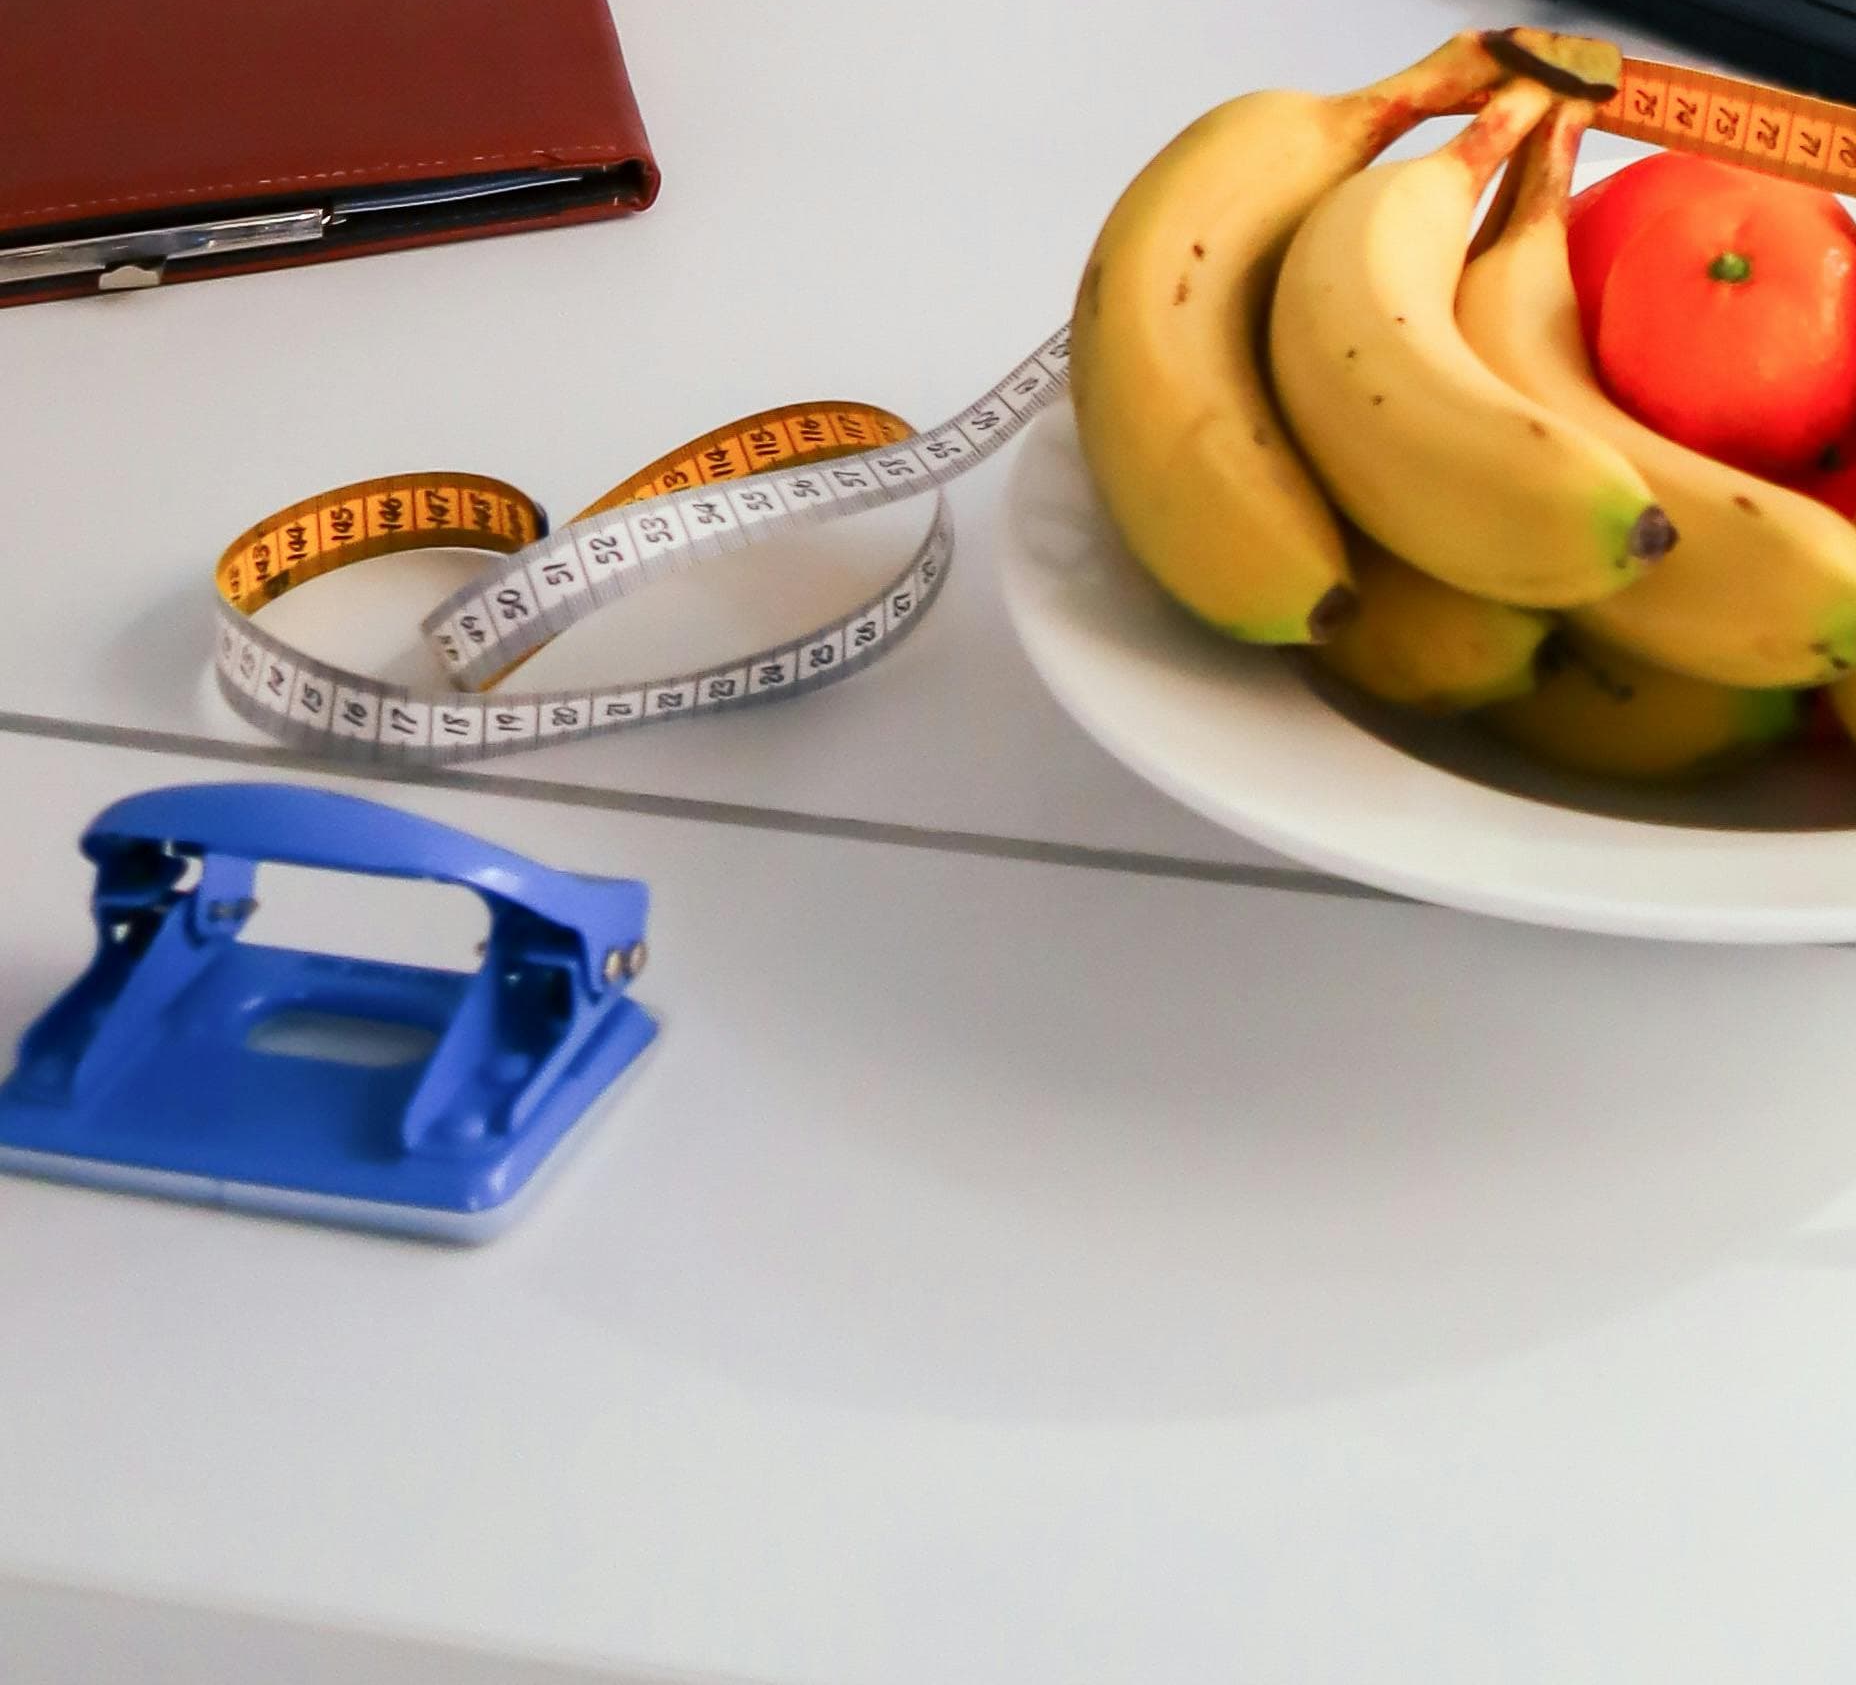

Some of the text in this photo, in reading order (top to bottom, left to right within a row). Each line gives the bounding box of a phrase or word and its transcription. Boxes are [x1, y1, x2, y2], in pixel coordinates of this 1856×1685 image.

[1634, 89, 1658, 119] 75
[1676, 97, 1697, 129] 74
[1716, 107, 1740, 141] 73
[1757, 117, 1780, 150] 72
[1799, 131, 1822, 158] 71
[704, 447, 736, 478] 114
[751, 430, 780, 458] 115
[800, 417, 826, 443] 116
[287, 522, 309, 562] 144
[331, 505, 354, 542] 145
[378, 493, 404, 530] 146
[497, 589, 528, 620] 50
[542, 562, 574, 586] 51
[590, 534, 624, 565] 52
[640, 516, 674, 545] 53
[692, 502, 726, 525] 54
[742, 490, 774, 511] 55
[792, 477, 821, 499] 56
[833, 469, 868, 490] 57
[878, 458, 915, 477] 58
[926, 440, 961, 459] 59
[391, 708, 417, 734] 17
[442, 713, 470, 735] 18
[496, 713, 523, 732] 19
[552, 706, 578, 728] 20
[606, 703, 633, 717] 21
[657, 692, 684, 709] 22
[709, 679, 736, 701] 23
[759, 664, 785, 687] 24
